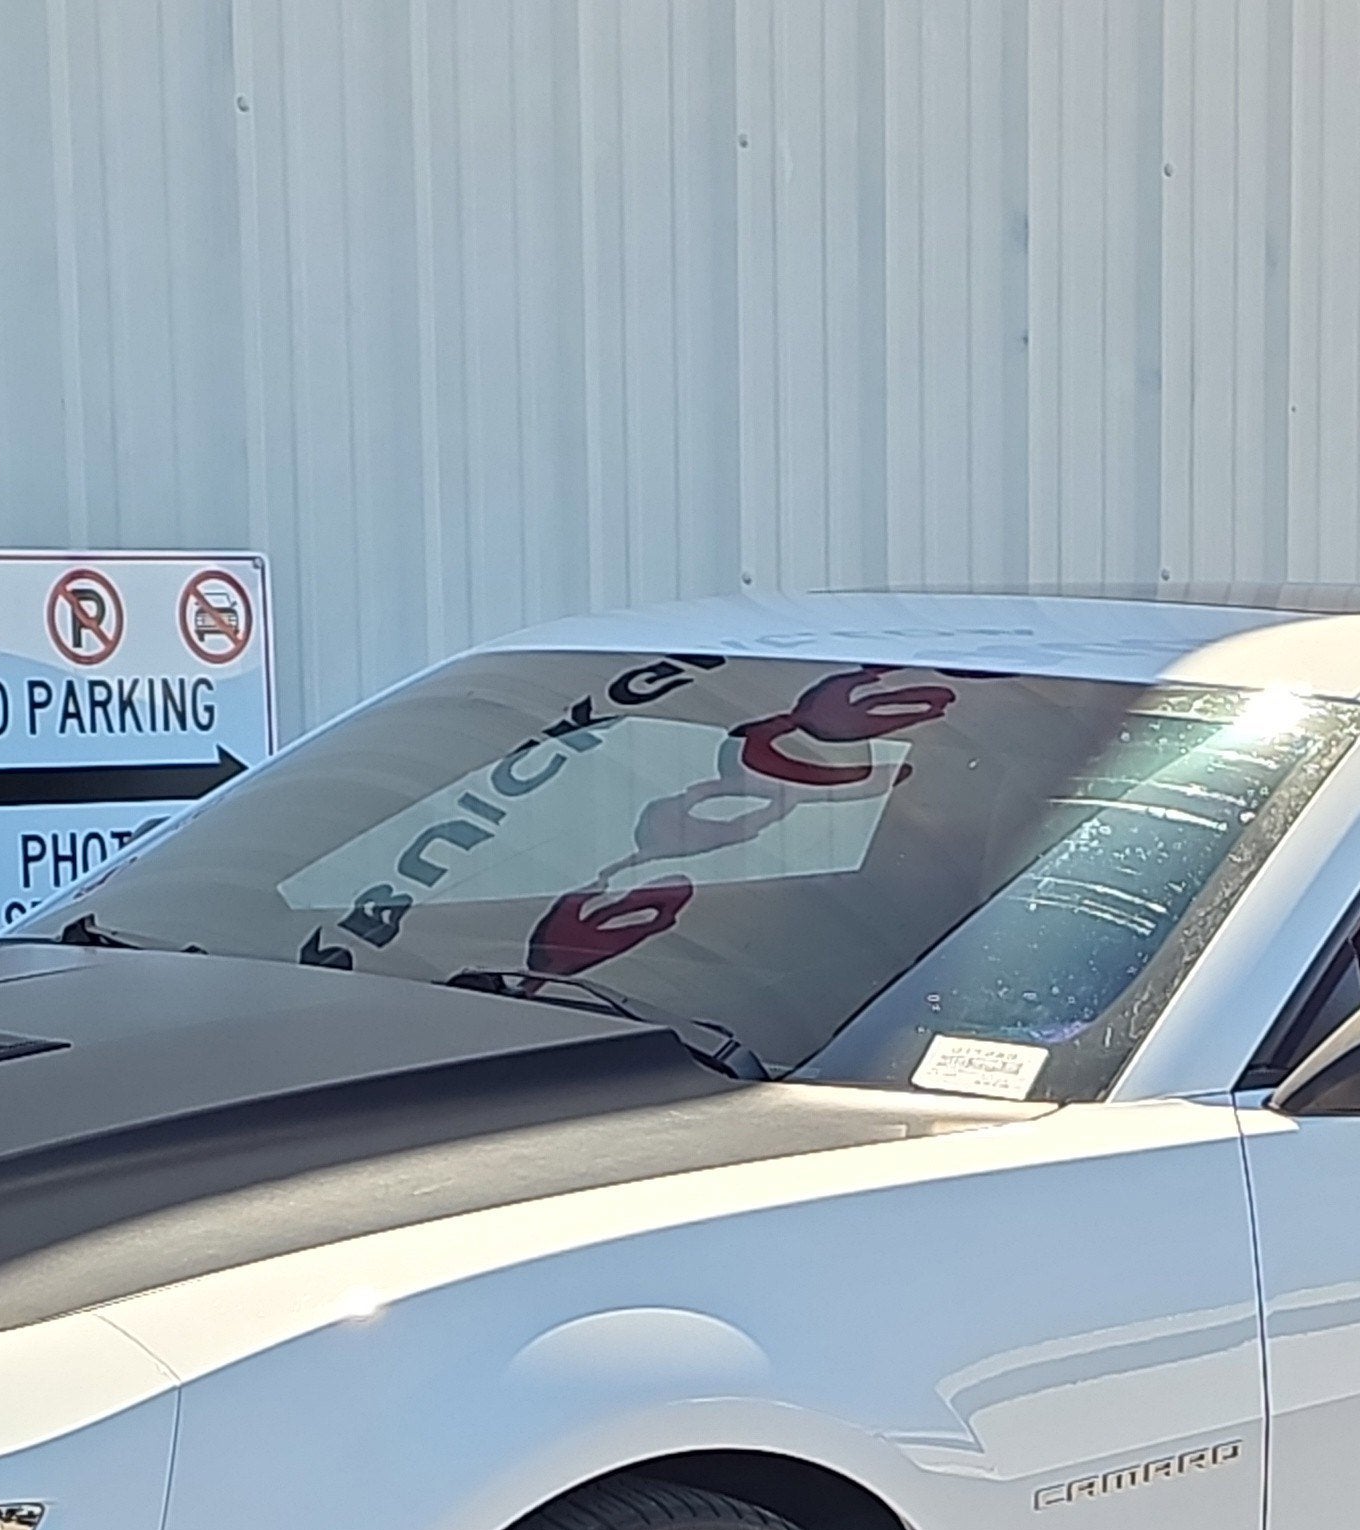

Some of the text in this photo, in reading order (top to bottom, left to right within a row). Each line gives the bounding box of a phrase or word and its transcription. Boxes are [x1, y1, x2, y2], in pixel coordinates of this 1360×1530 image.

[28, 676, 216, 735] PARKING
[21, 830, 133, 888] PHOT
[1033, 1439, 1243, 1511] CAMARO
